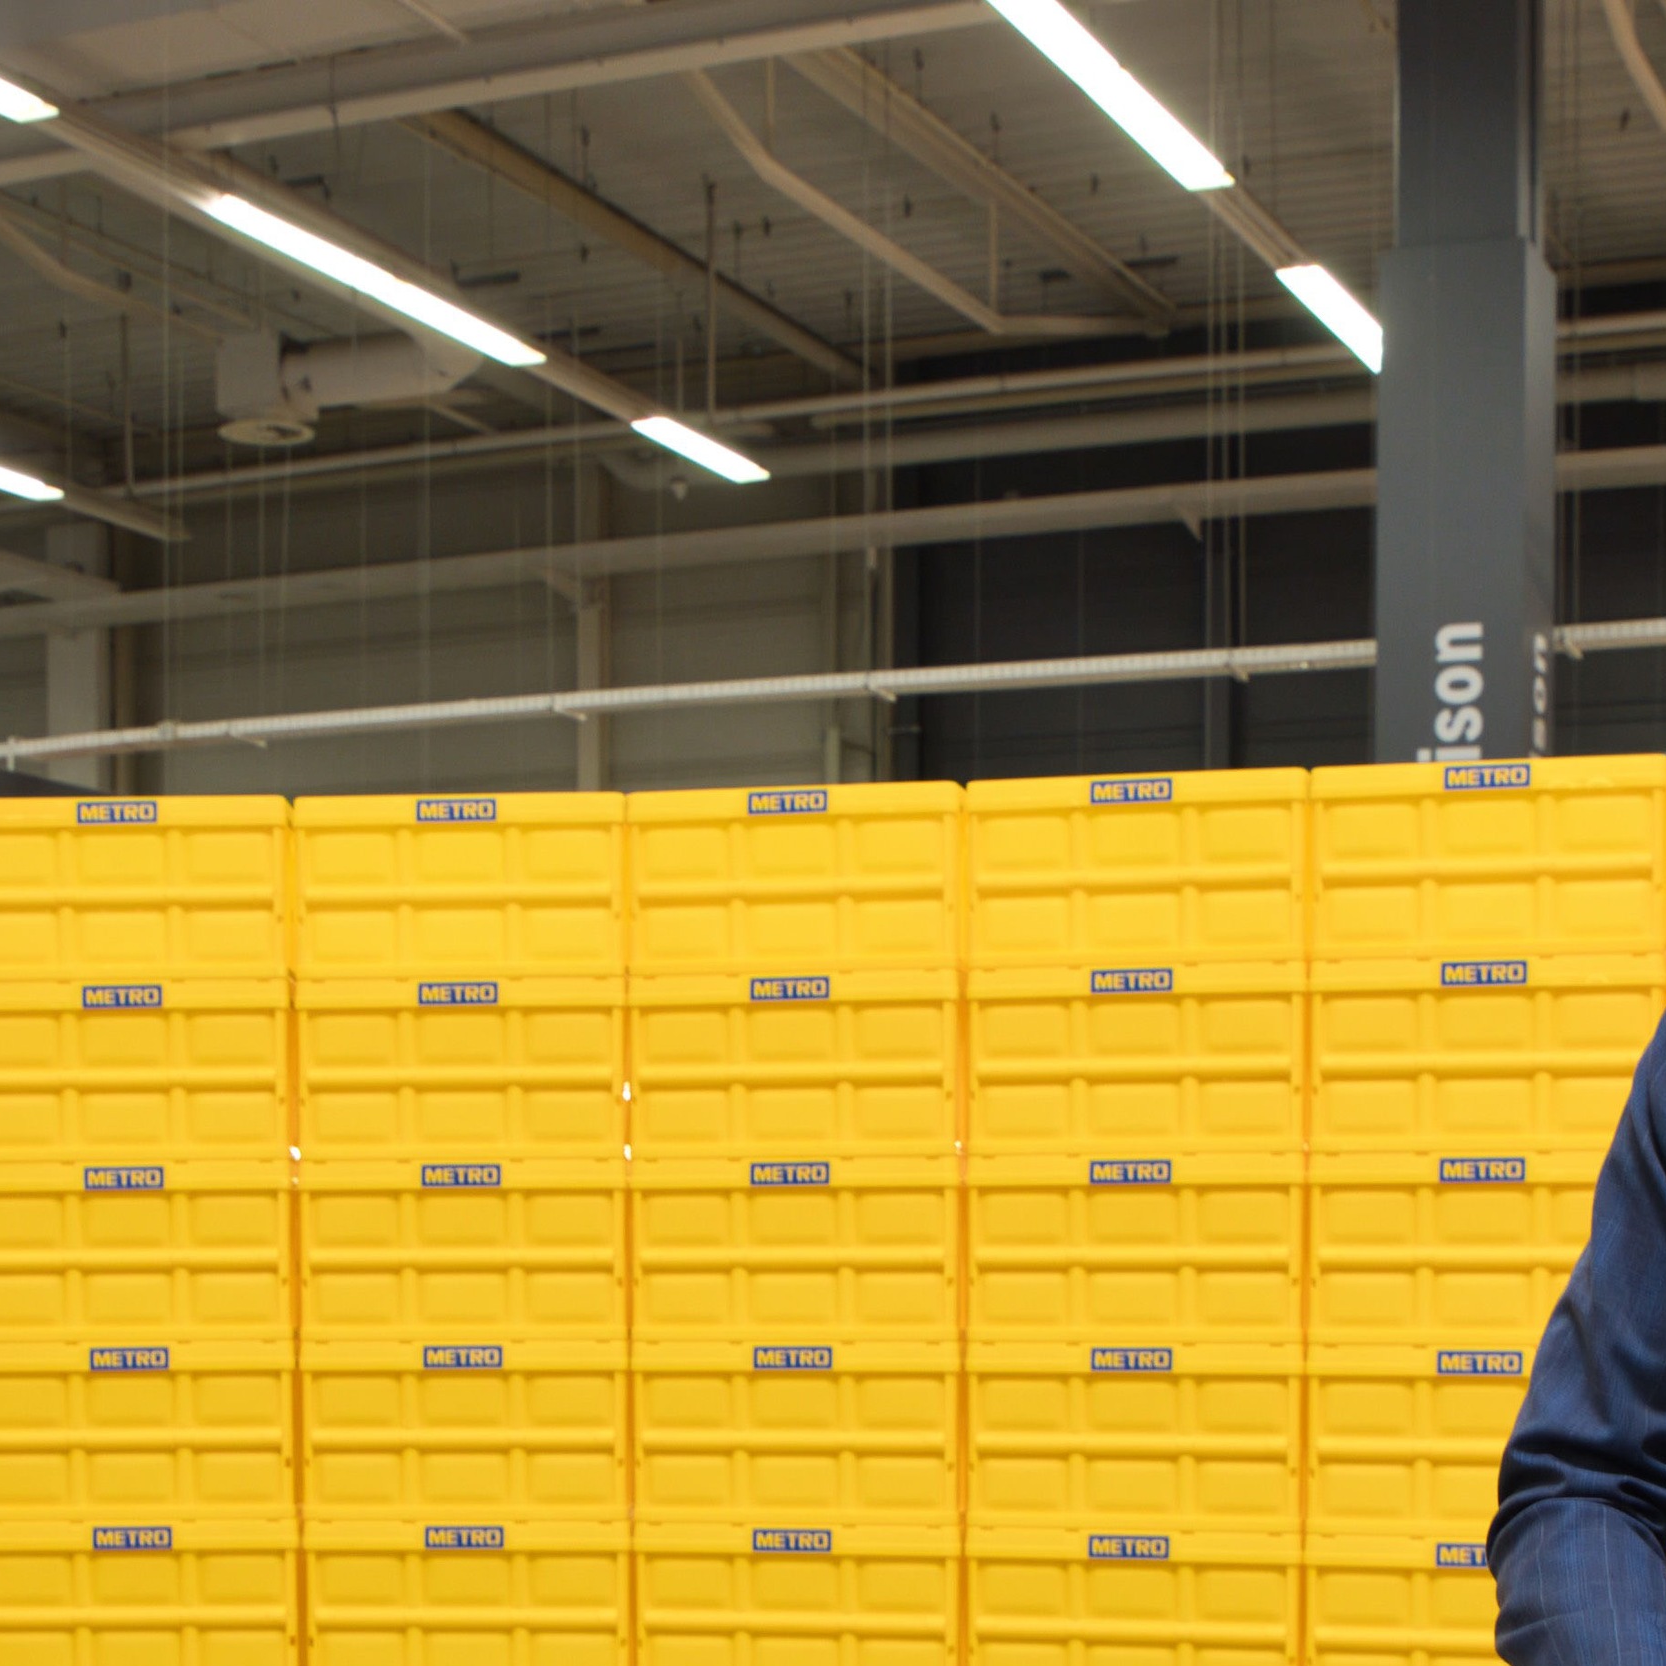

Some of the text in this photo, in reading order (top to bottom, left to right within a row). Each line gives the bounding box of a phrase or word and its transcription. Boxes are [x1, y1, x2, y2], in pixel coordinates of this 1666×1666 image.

[1446, 766, 1527, 786] METRO
[1094, 781, 1169, 800] METRO
[419, 802, 494, 818] METRO
[750, 793, 823, 811] METRO
[80, 804, 154, 820] METRO
[1094, 972, 1170, 989] METRO
[1444, 964, 1524, 982] METRO
[85, 988, 159, 1004] METRO
[421, 985, 495, 1001] METRO
[753, 980, 827, 997] METRO
[425, 1168, 498, 1183] METRO
[754, 1166, 827, 1182] METRO
[1093, 1164, 1169, 1180] METRO
[1443, 1161, 1522, 1178] METRO
[87, 1170, 161, 1186] METRO
[93, 1351, 166, 1367] METRO
[426, 1349, 500, 1365] METRO
[756, 1350, 830, 1366] METRO
[1094, 1351, 1170, 1367] METRO
[1440, 1355, 1519, 1372] METRO
[96, 1530, 169, 1546] METRO
[428, 1530, 502, 1545] METRO
[756, 1533, 829, 1549] METRO
[1092, 1539, 1167, 1555] METRO
[1439, 1546, 1485, 1563] MET
